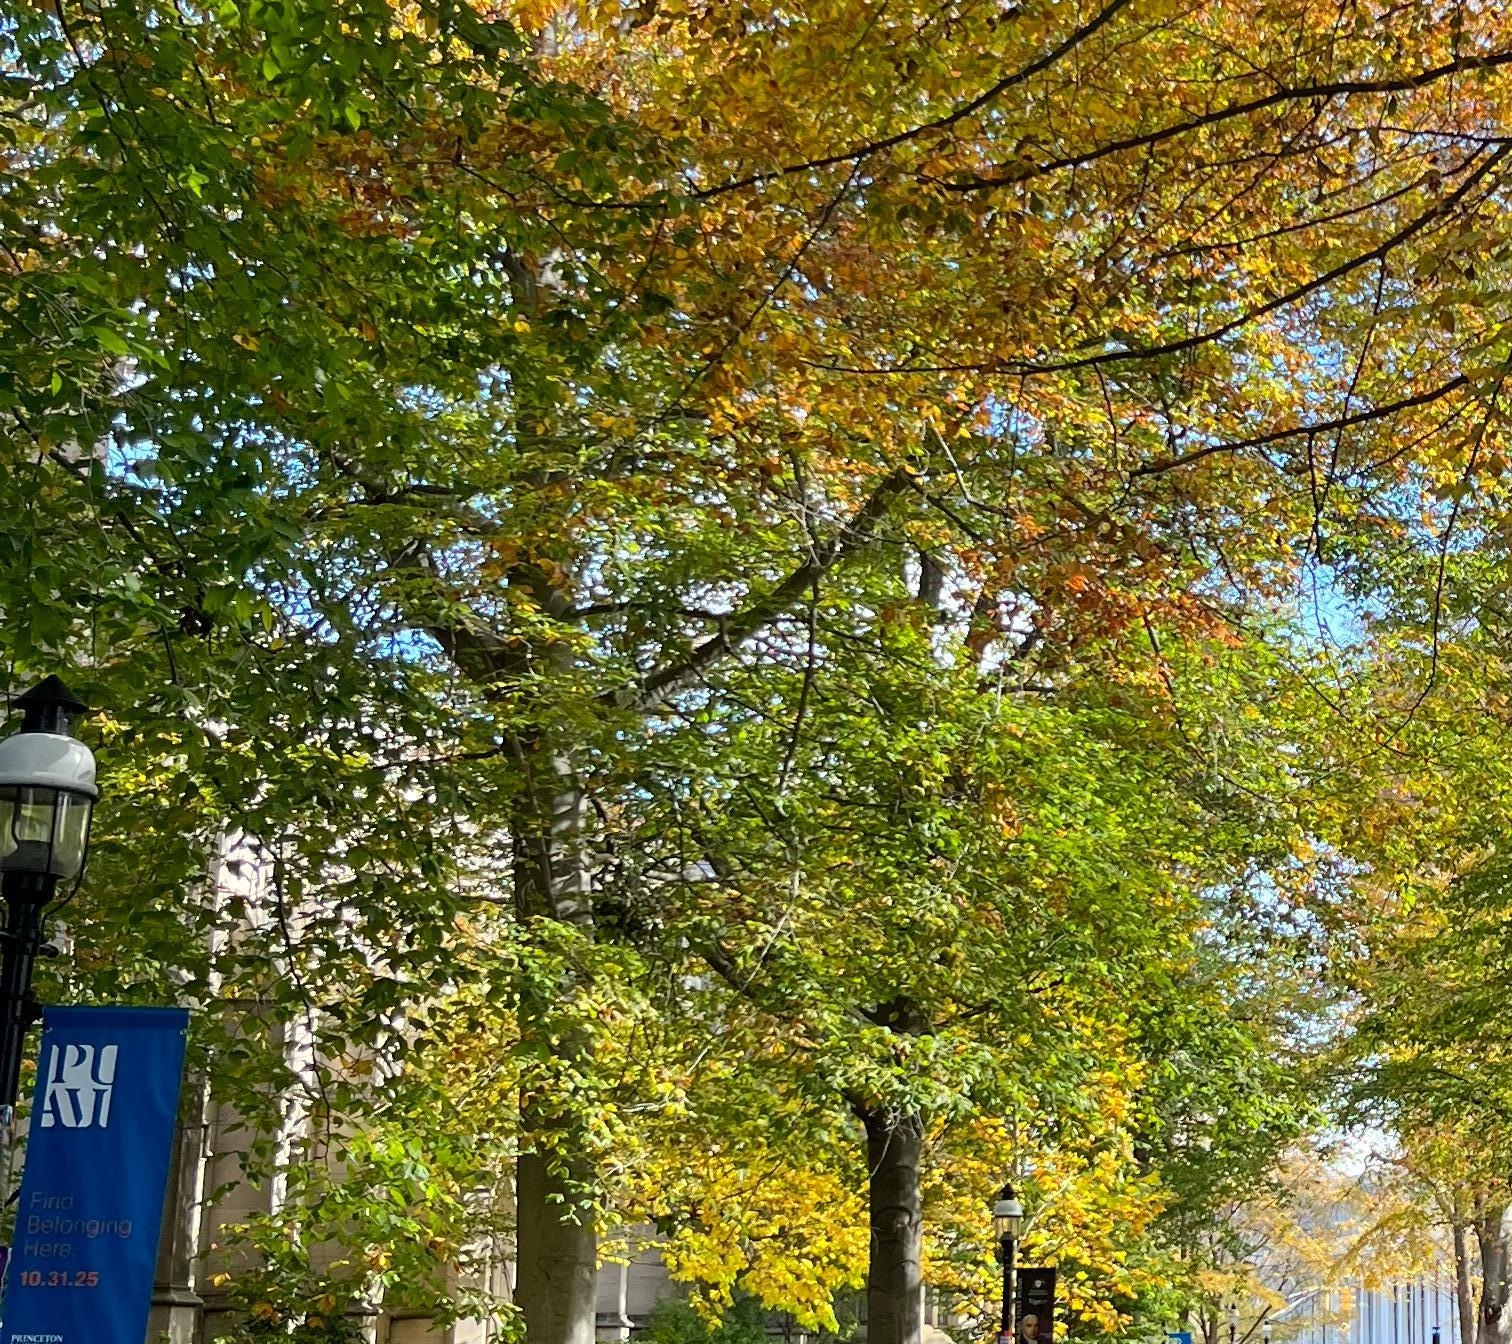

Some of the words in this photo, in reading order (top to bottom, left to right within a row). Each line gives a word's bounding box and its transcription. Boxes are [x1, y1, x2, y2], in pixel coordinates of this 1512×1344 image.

[30, 1191, 74, 1210] Find
[27, 1215, 132, 1239] Belonging
[23, 1239, 72, 1258] Here
[19, 1270, 99, 1287] 10.31.25
[11, 1334, 63, 1343] PRINCETON
